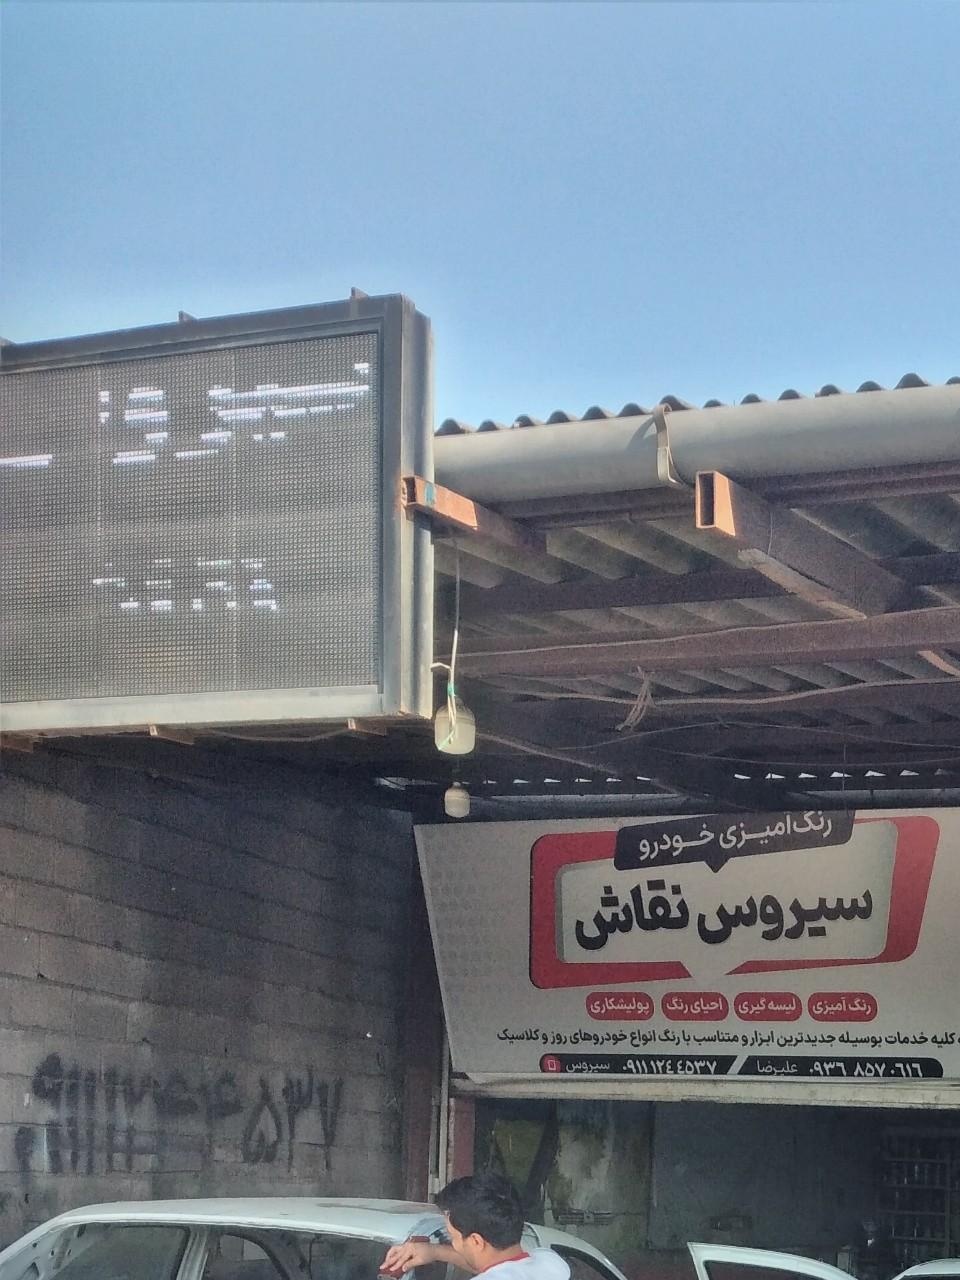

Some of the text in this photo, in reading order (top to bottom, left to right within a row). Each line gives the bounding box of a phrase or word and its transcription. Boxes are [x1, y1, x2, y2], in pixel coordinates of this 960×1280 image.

[639, 822, 715, 861] خودرو
[575, 878, 873, 950] سیروس نقاش
[590, 997, 651, 1015] پولیشکاری
[666, 997, 723, 1014] احیای رنگ
[738, 998, 797, 1015] لیسه گیری
[848, 997, 872, 1015] رنگ
[497, 1028, 540, 1045] کلاسیک
[542, 1033, 549, 1044] و
[551, 1030, 567, 1045] روز
[570, 1028, 627, 1046] خودروهای
[630, 1029, 657, 1047] انواع
[658, 1029, 681, 1046] رنگ
[681, 1029, 691, 1046] با
[693, 1030, 739, 1046] متناسب
[741, 1034, 749, 1047] و
[750, 1030, 775, 1047] ابزار
[777, 1031, 836, 1048] جدیدترین
[885, 1031, 929, 1045] خدمات
[931, 1031, 956, 1048] کلیه
[565, 1061, 610, 1073] سیروس
[756, 1060, 799, 1075] علیرضا
